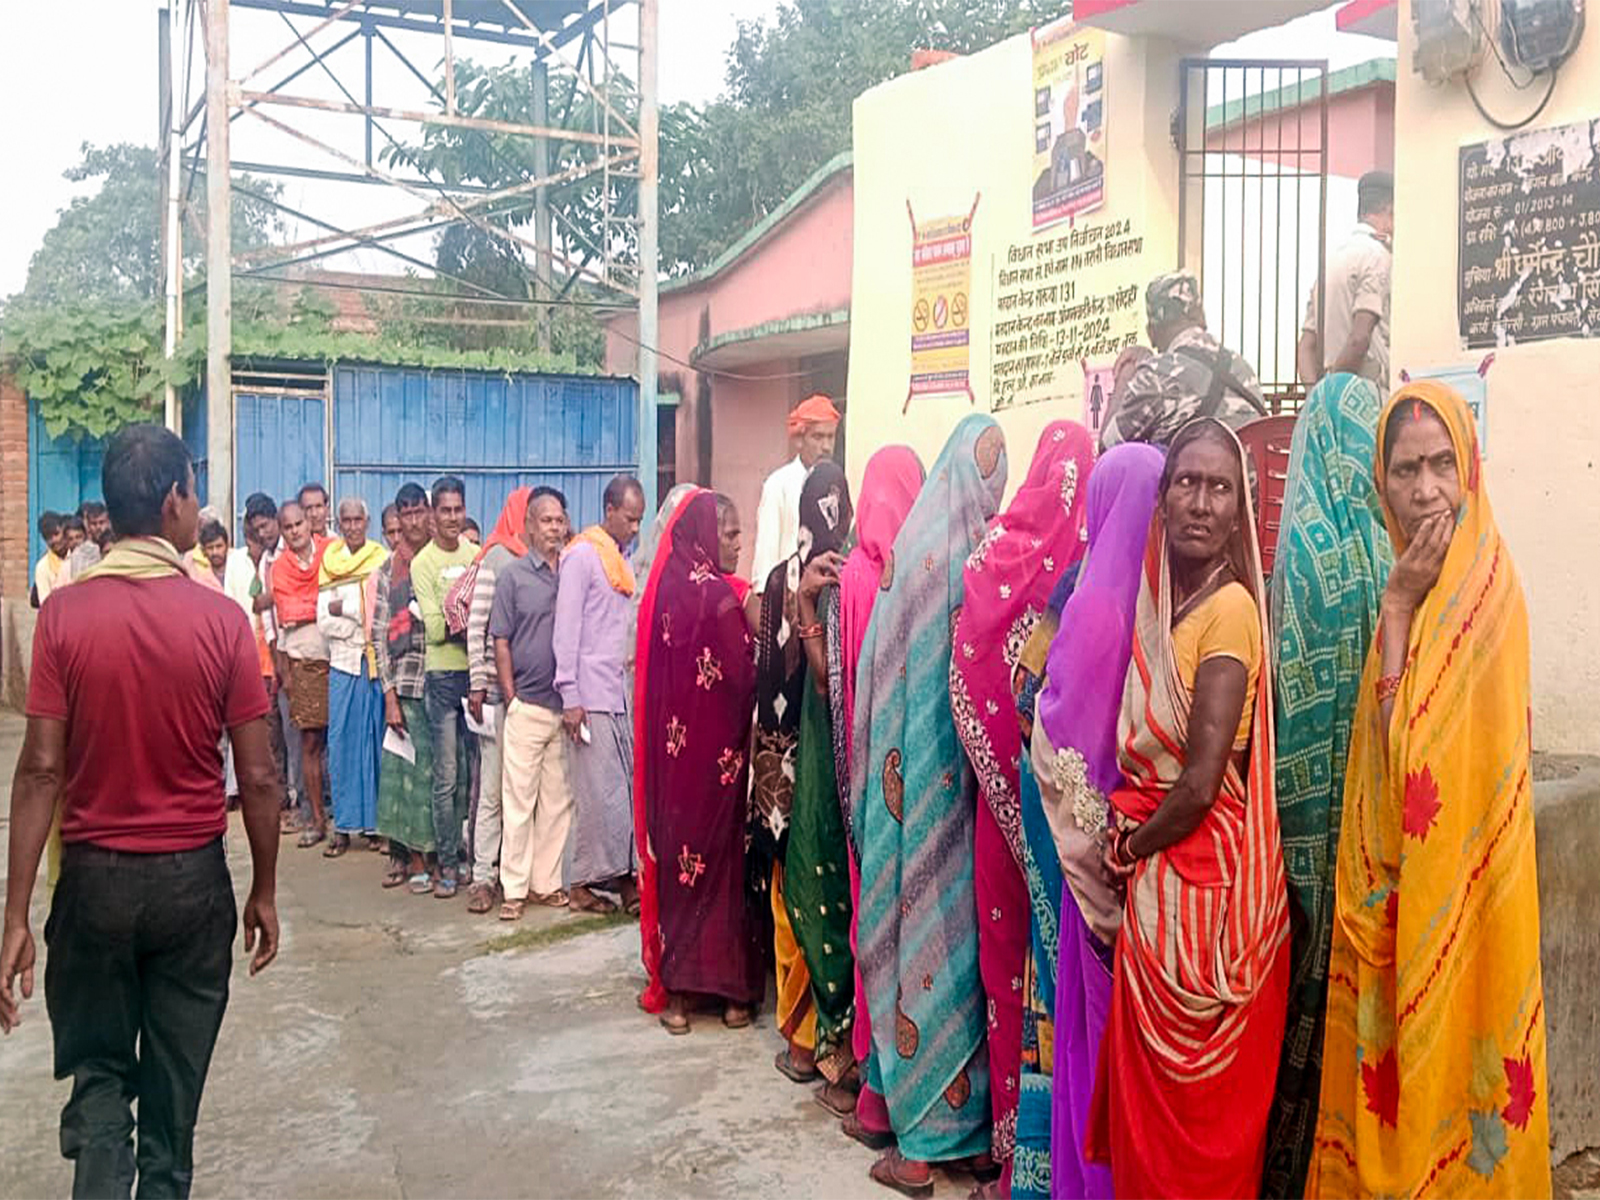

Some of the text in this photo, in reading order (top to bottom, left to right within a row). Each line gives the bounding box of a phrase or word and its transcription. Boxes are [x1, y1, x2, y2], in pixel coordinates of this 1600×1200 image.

[1008, 244, 1034, 265] विधान
[1035, 239, 1054, 260] सभा
[1055, 236, 1069, 253] उप
[1060, 280, 1075, 302] 131
